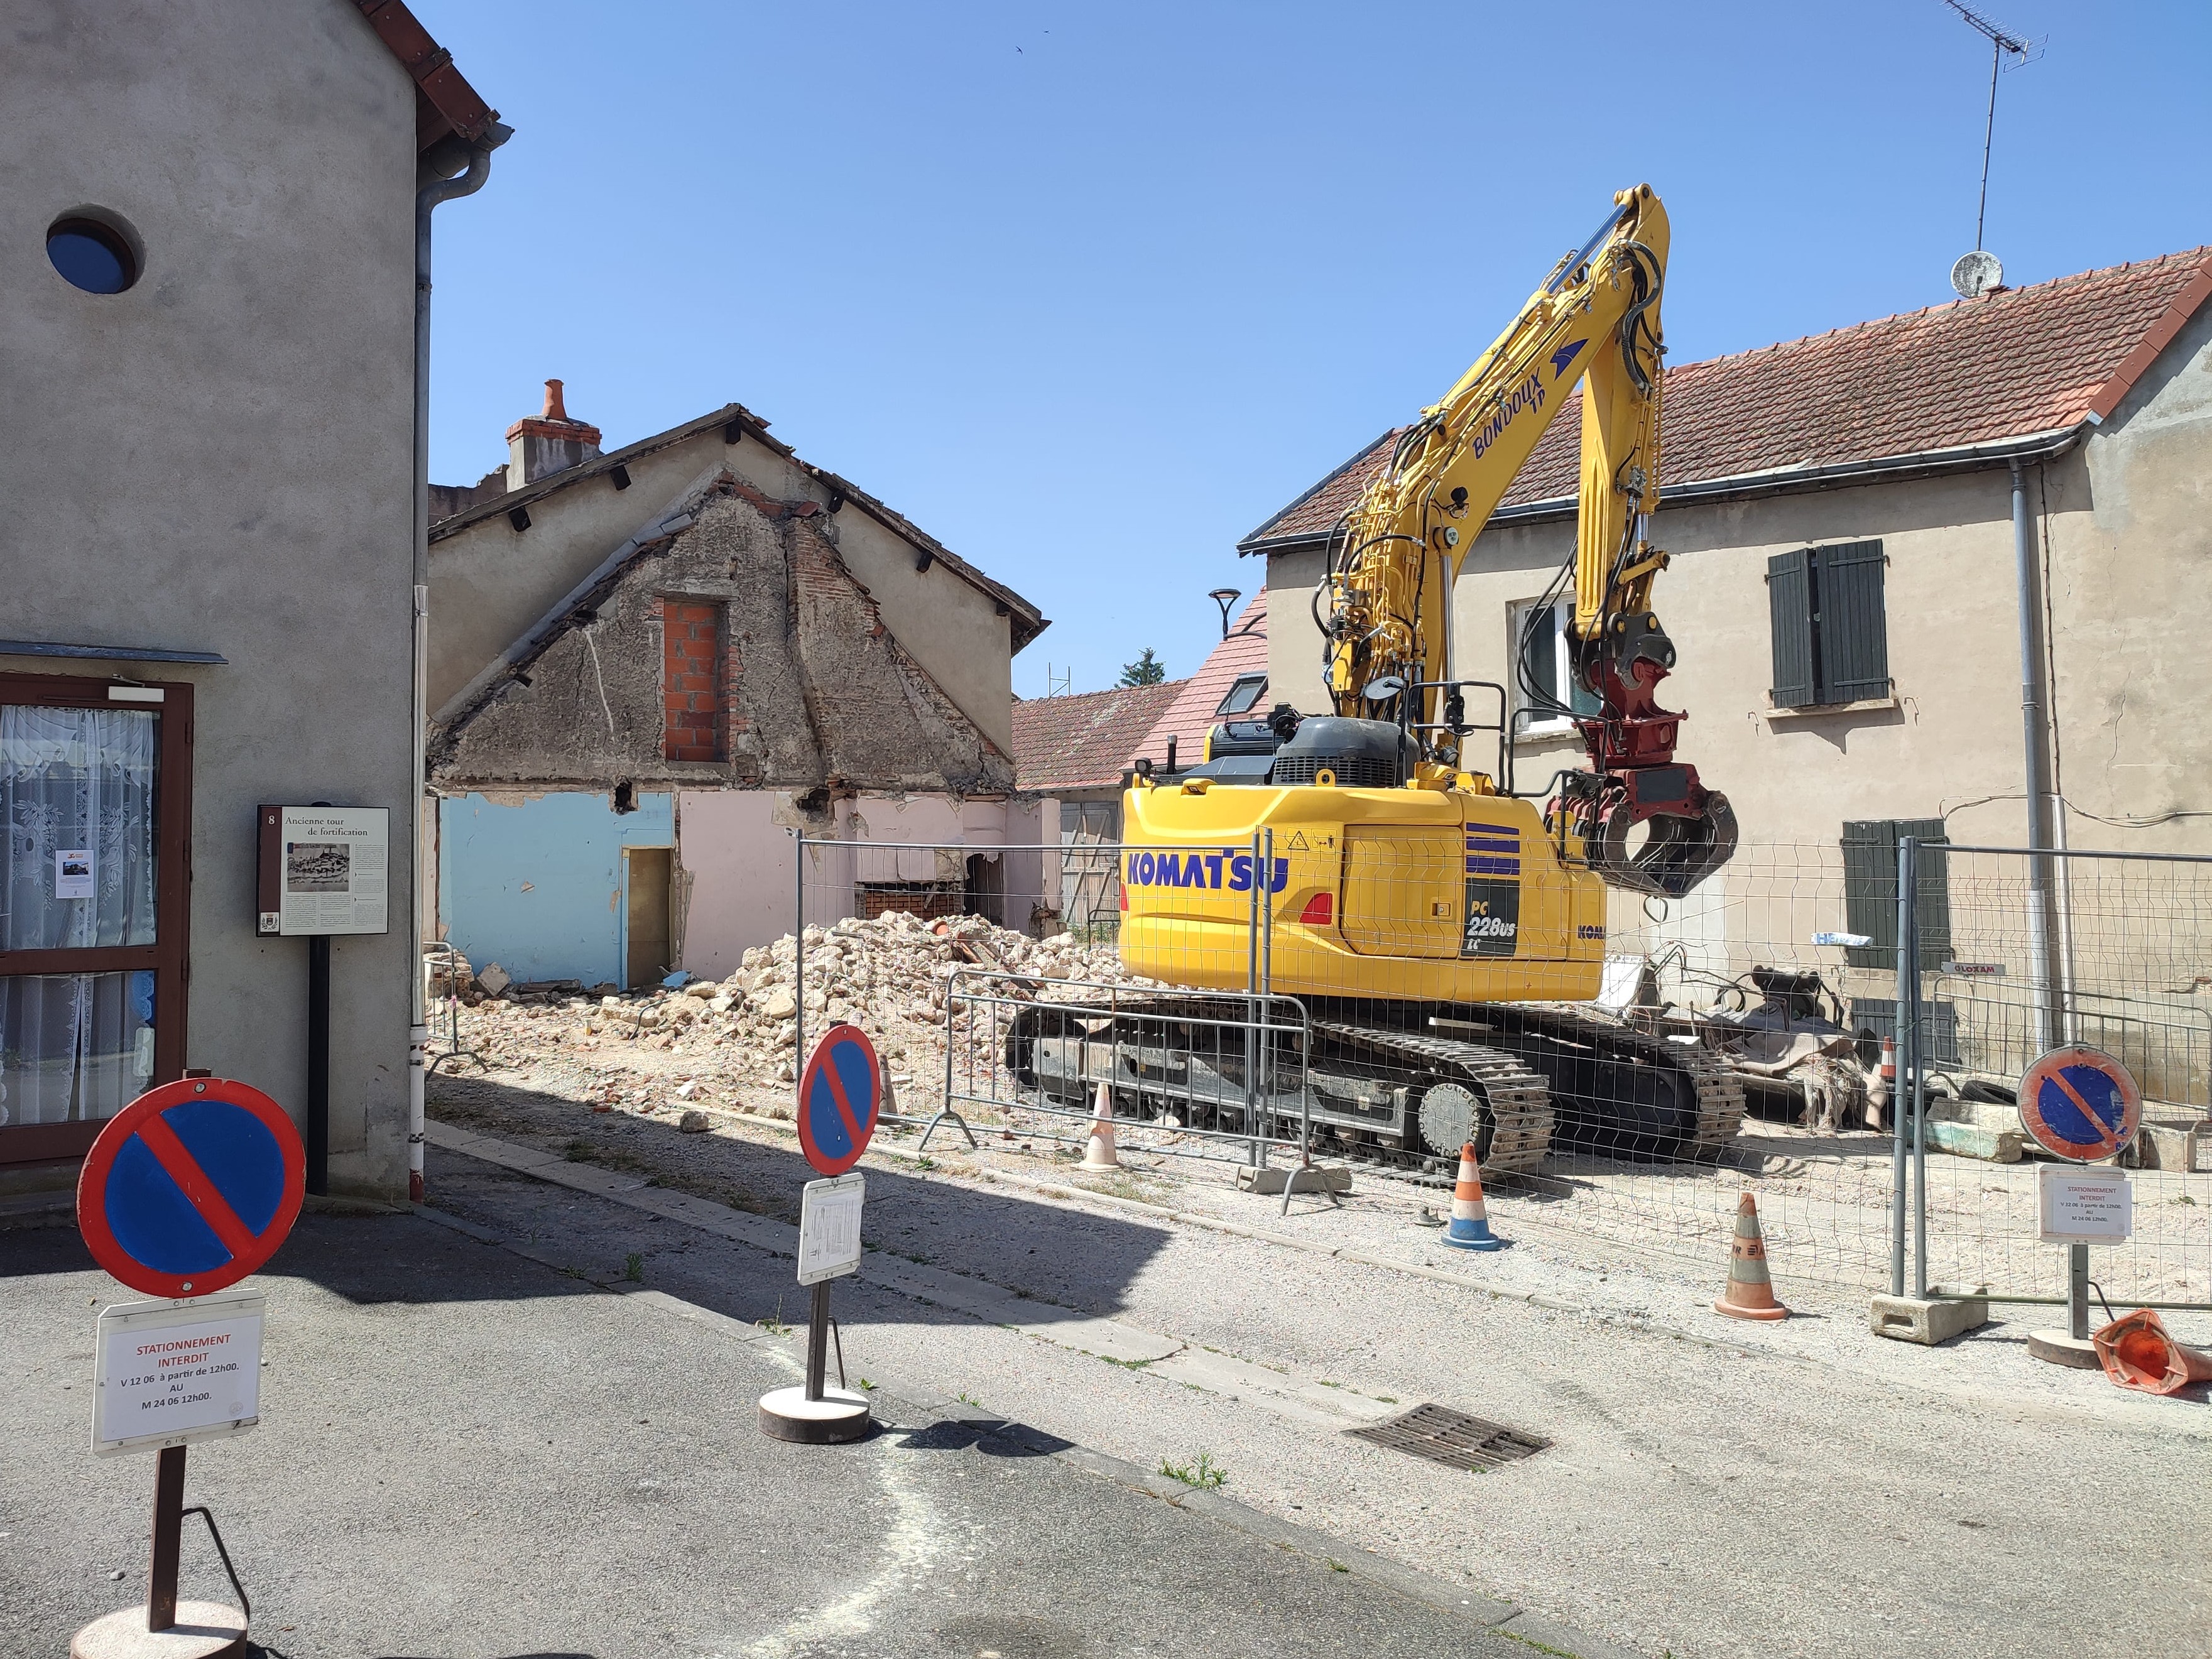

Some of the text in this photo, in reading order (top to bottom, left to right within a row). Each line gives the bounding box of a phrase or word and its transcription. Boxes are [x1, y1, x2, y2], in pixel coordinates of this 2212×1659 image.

[1529, 389, 1545, 415] TP
[1472, 366, 1543, 459] BONDOUX
[268, 815, 275, 825] 8
[285, 817, 324, 825] Ancienne
[308, 827, 368, 835] de fortification
[1128, 849, 1289, 893] KOMATSU
[1471, 901, 1488, 915] PC
[136, 1334, 231, 1356] STATIONNEMENT
[158, 1352, 209, 1368] INTERDIT
[130, 1377, 141, 1386] 12
[144, 1375, 155, 1384] 06
[160, 1373, 165, 1381] à
[168, 1369, 193, 1382] partir
[195, 1368, 207, 1376] de
[210, 1363, 239, 1374] 12h00.
[170, 1383, 183, 1393] AU
[141, 1401, 151, 1410] M
[154, 1400, 165, 1408] 24
[182, 1392, 212, 1403] 12h00.
